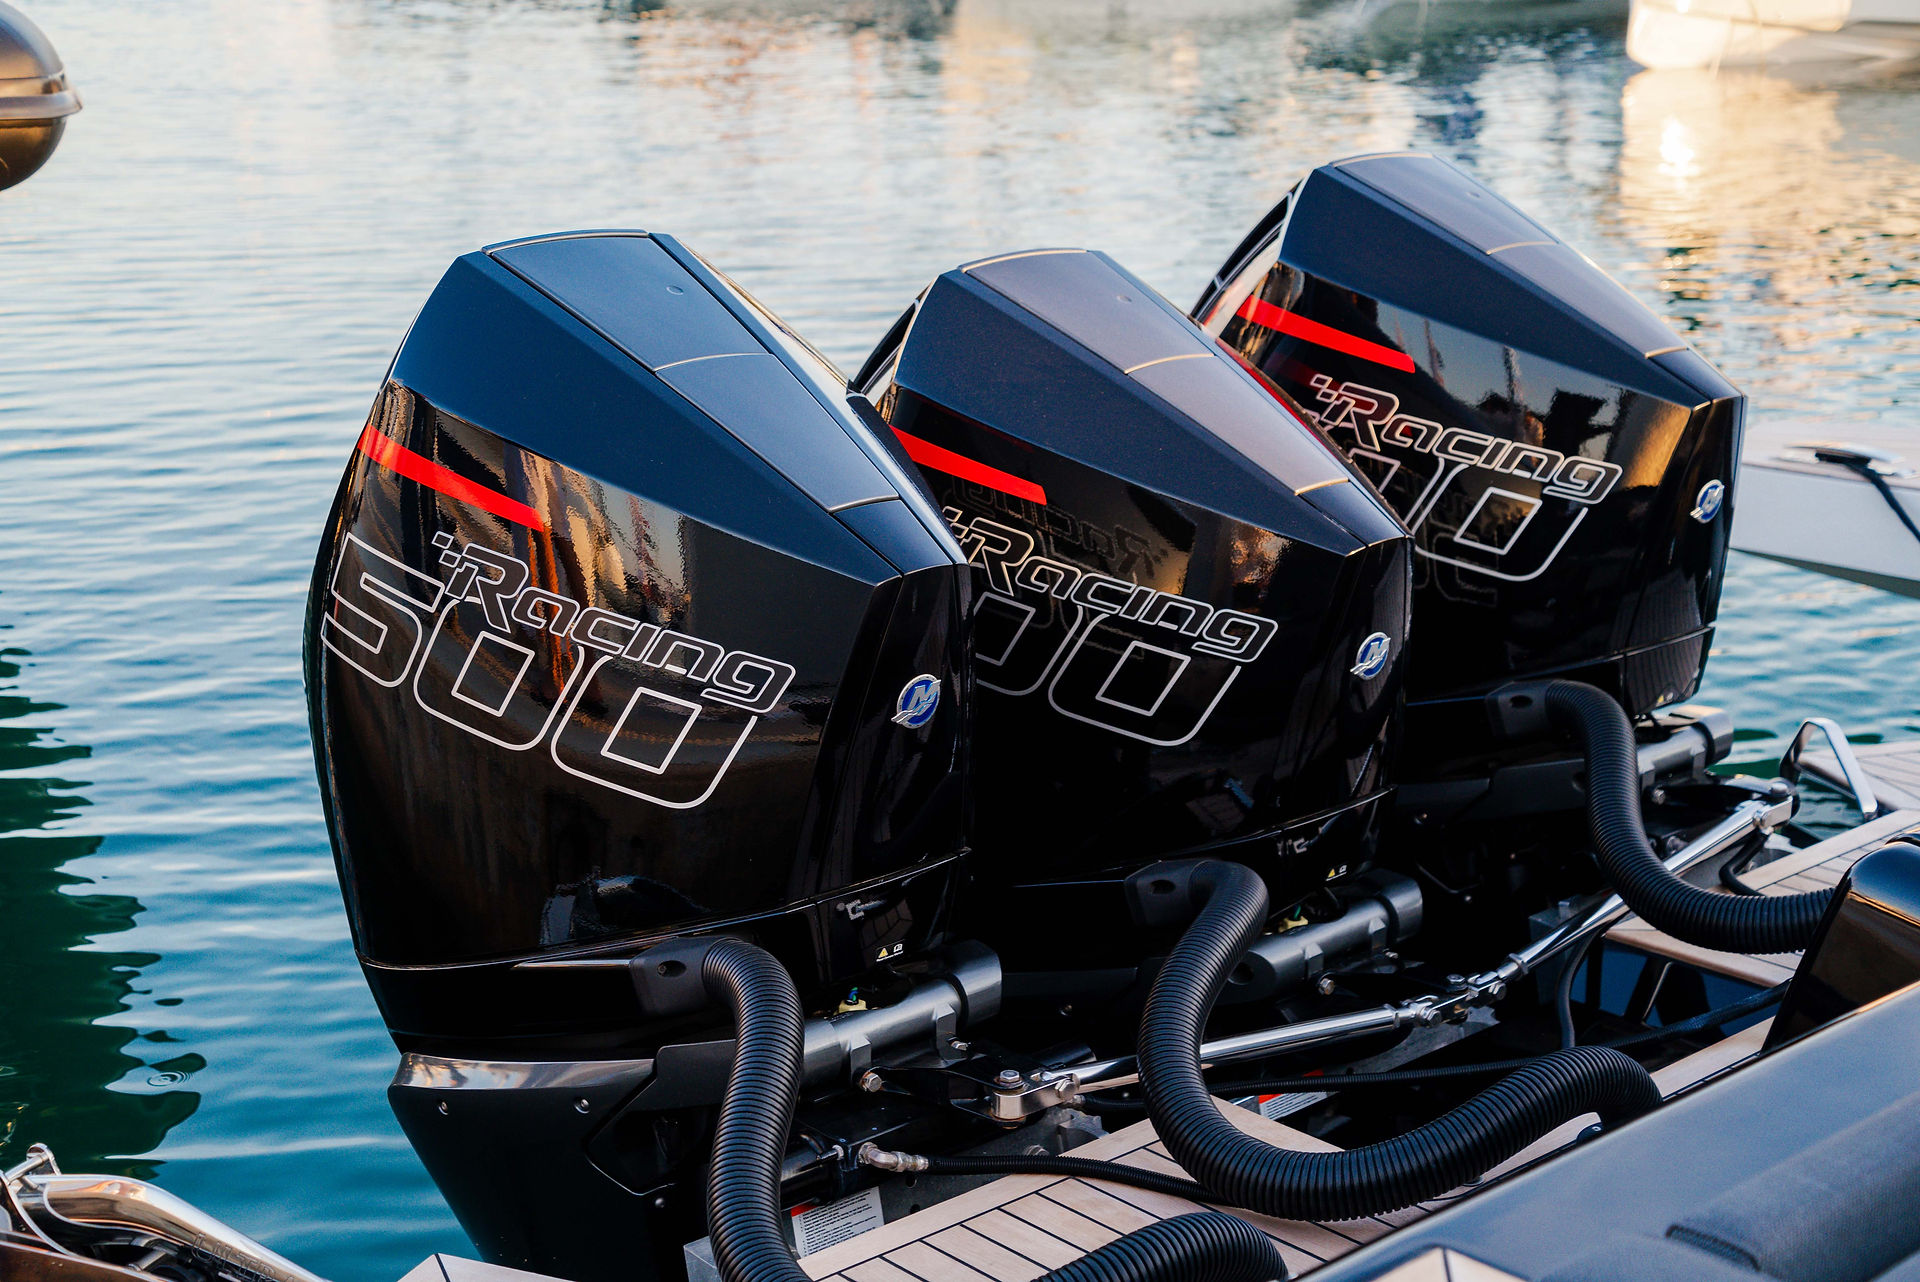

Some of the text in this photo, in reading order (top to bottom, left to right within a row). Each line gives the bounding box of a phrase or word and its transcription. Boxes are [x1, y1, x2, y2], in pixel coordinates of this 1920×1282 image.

[1310, 374, 1624, 505] Racing
[432, 531, 796, 714] Racing
[942, 506, 1279, 664] Racing
[967, 561, 1241, 747] 00
[320, 532, 758, 810] 500
[191, 1232, 296, 1282] ULTR
